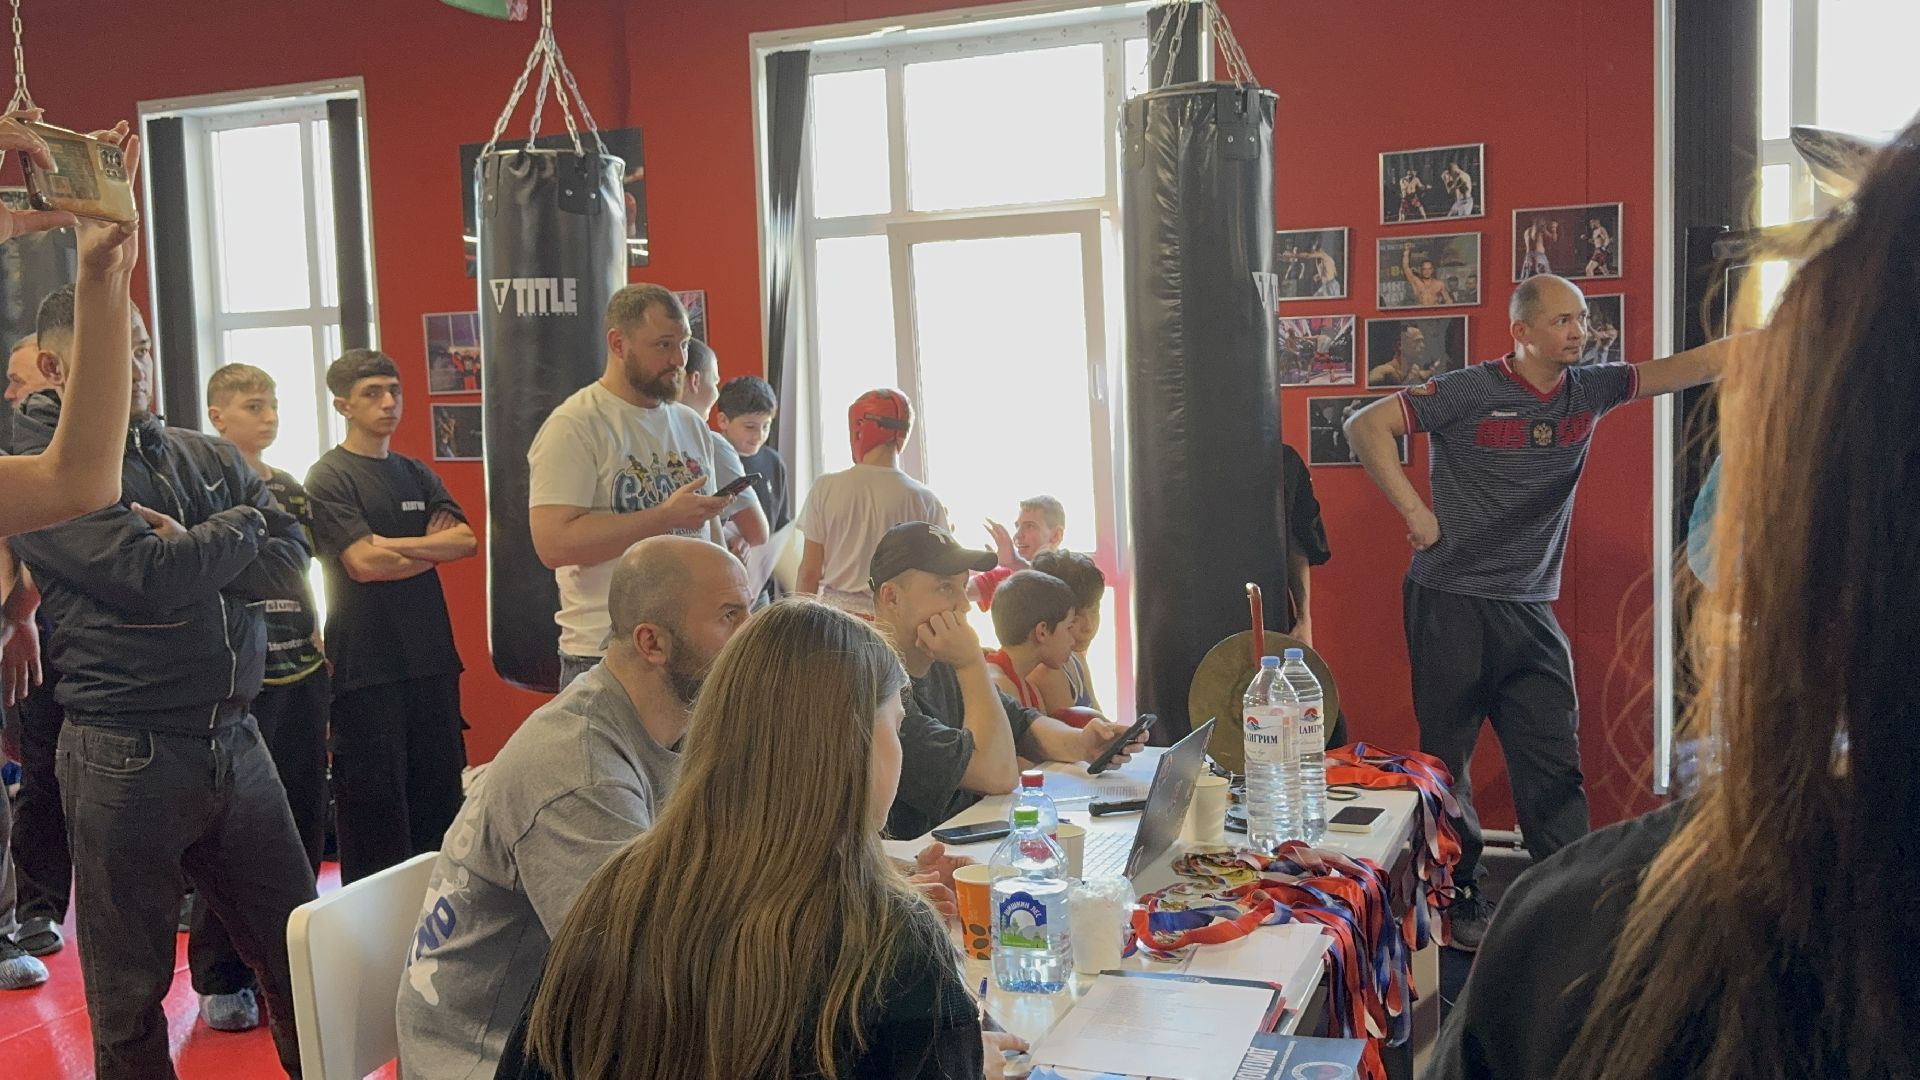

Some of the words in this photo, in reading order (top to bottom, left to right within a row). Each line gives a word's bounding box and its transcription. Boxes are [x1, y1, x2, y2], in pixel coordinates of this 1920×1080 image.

[513, 278, 578, 313] TITLE
[1030, 906, 1042, 918] ЛЕС
[1231, 1046, 1278, 1080] ДИПЛО
